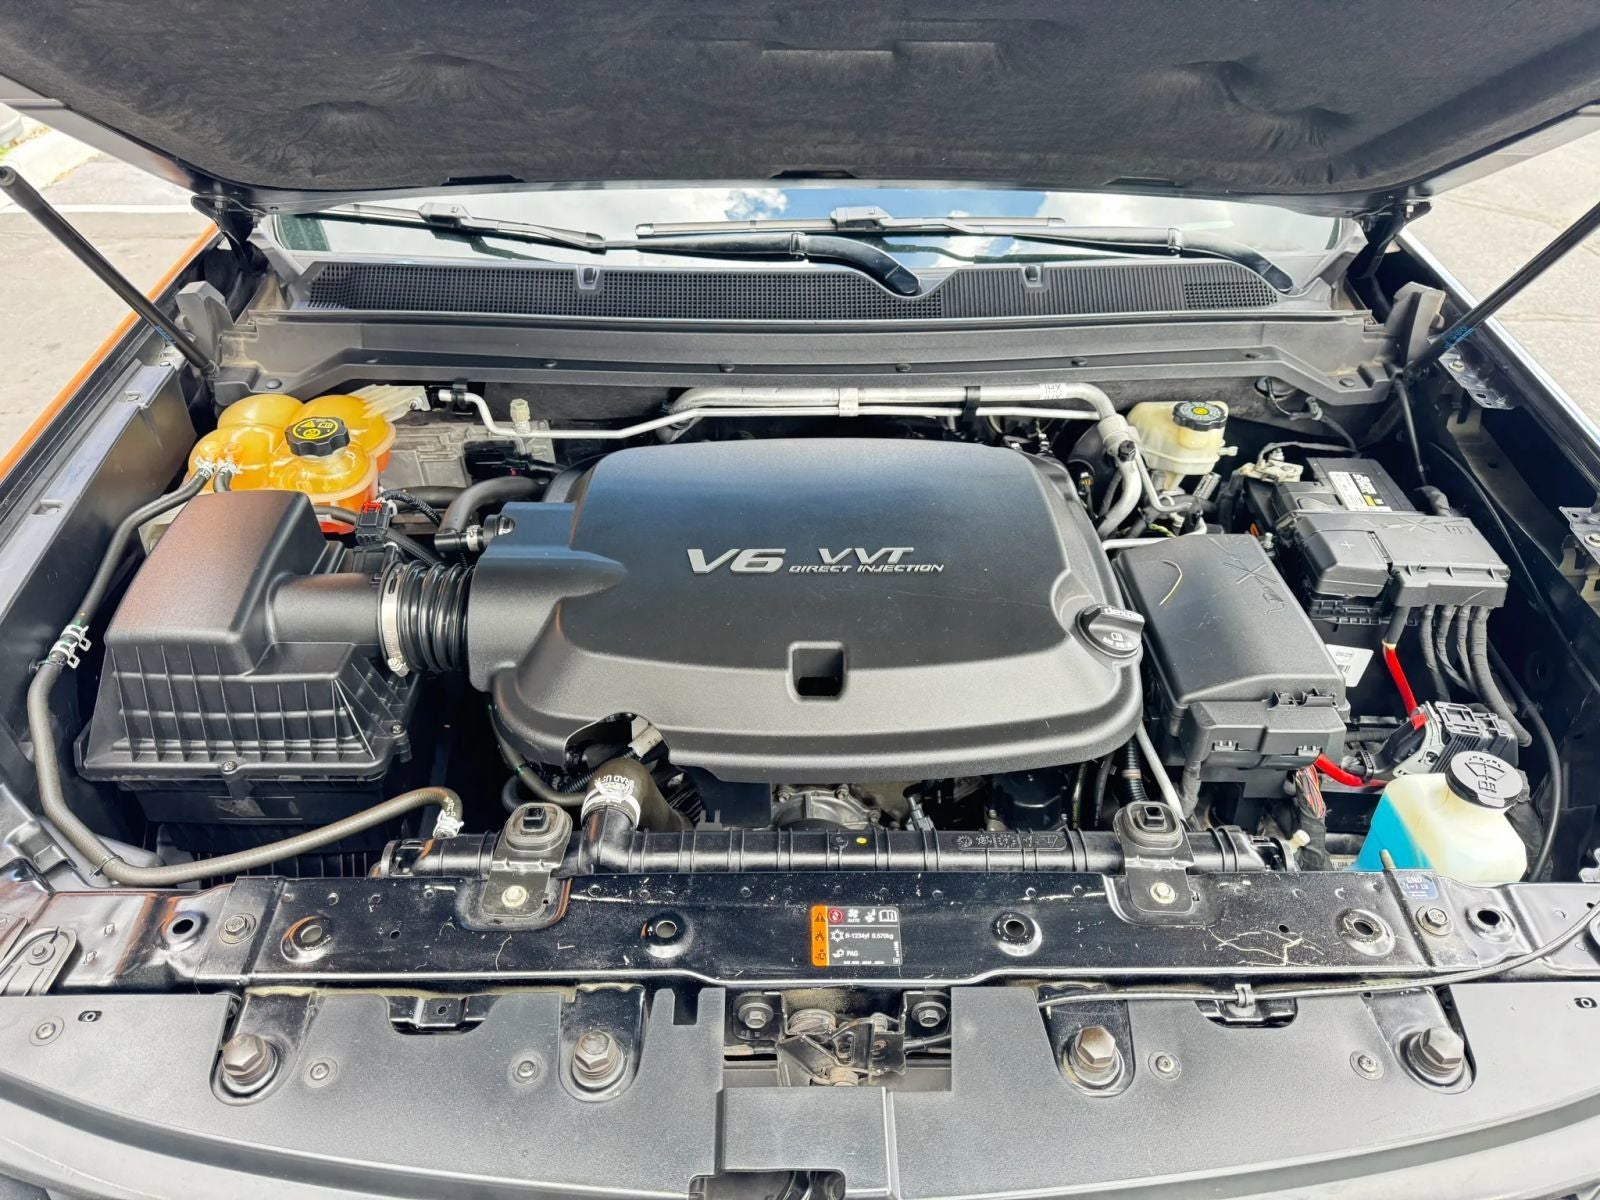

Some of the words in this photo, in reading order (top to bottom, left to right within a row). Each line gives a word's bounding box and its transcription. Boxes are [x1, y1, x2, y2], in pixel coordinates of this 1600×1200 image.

[687, 548, 787, 574] V6
[819, 547, 915, 565] VVT
[788, 565, 852, 574] DIRECT
[857, 564, 945, 574] INJECTION
